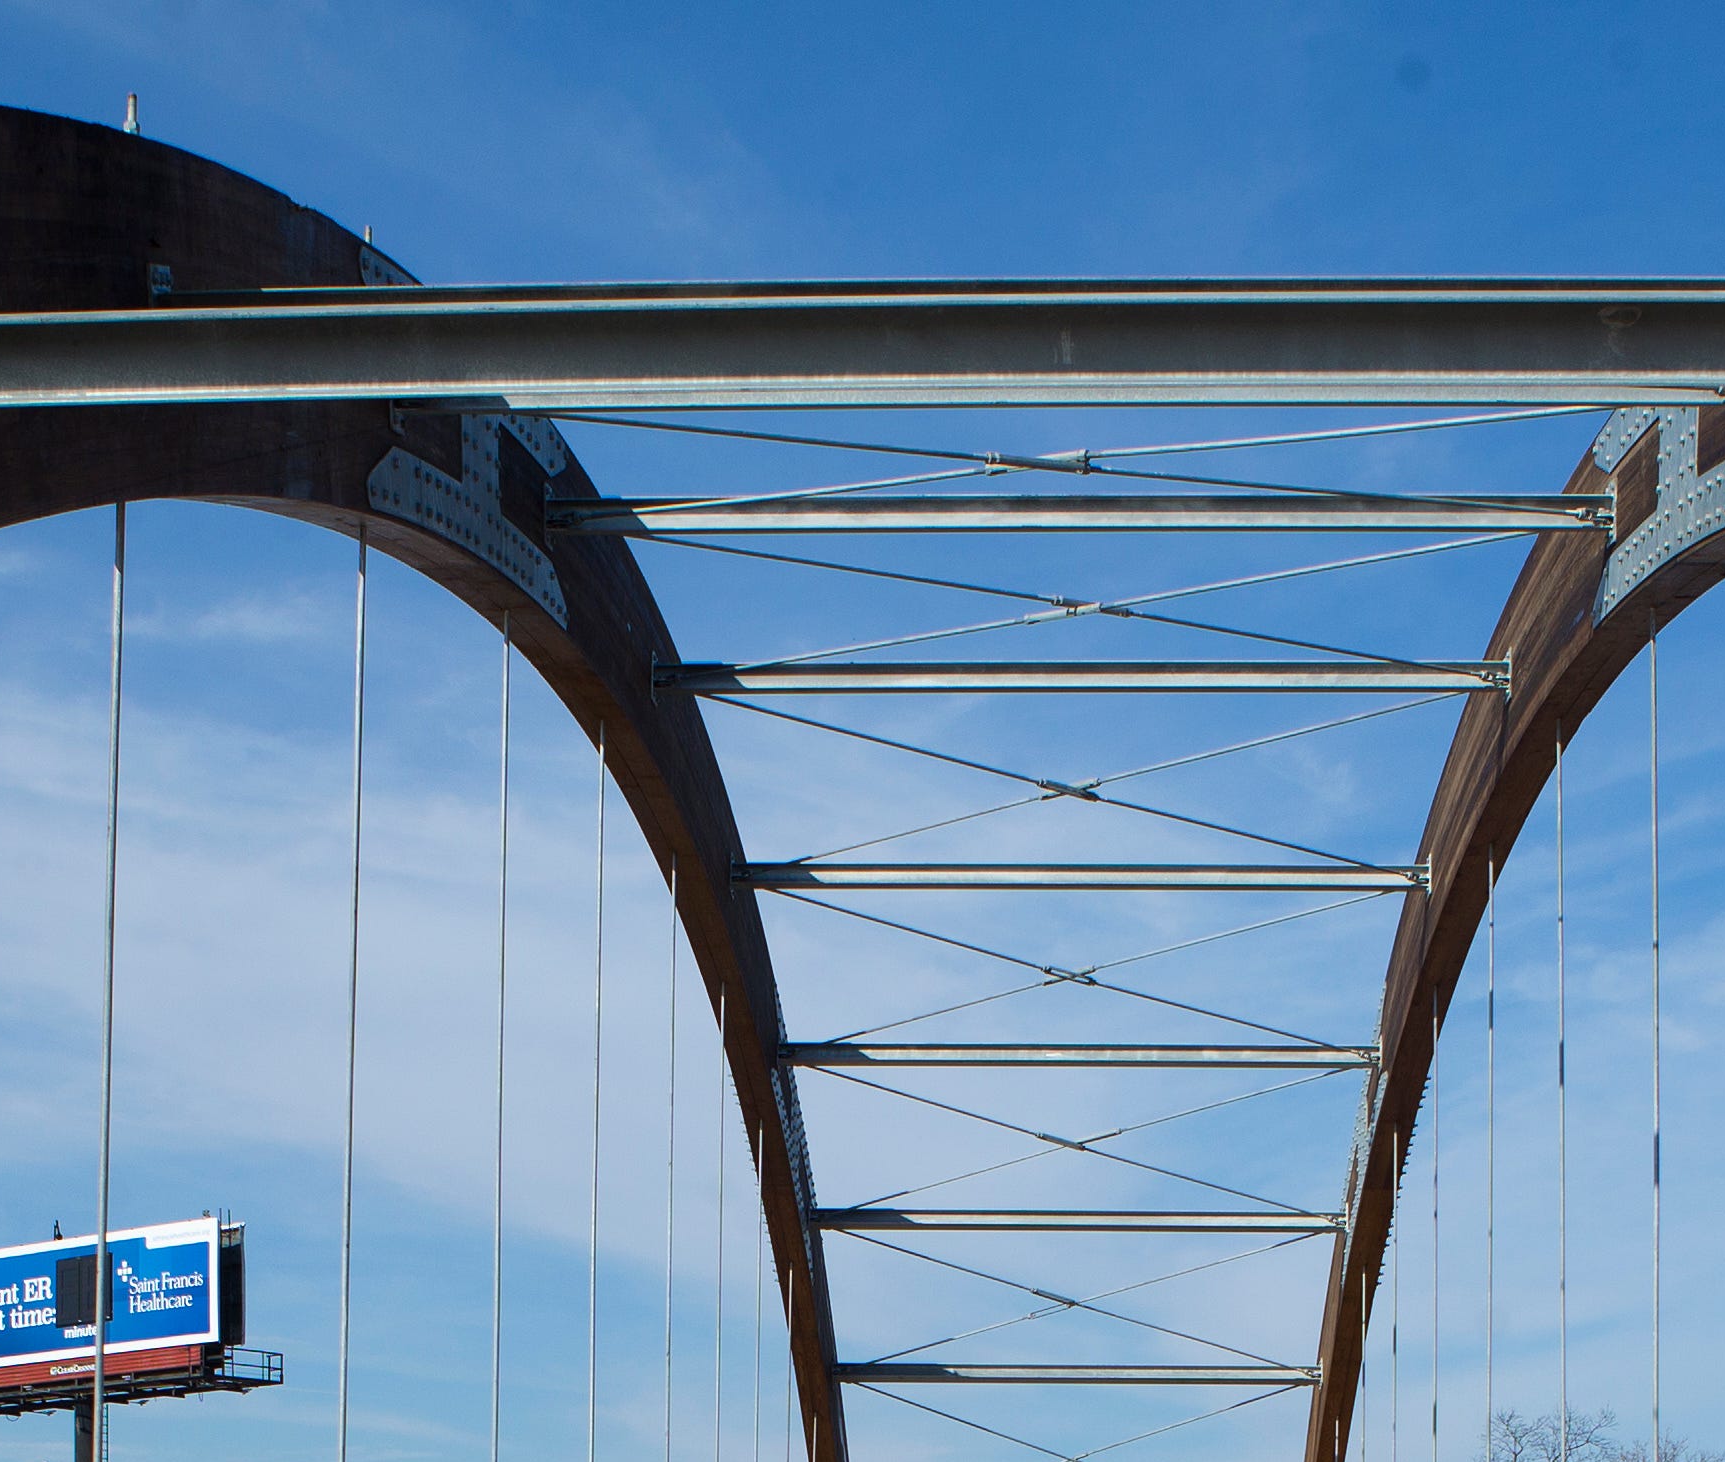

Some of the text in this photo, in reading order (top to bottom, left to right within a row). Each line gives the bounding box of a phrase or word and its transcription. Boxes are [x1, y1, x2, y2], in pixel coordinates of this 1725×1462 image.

[23, 1276, 54, 1303] ER
[129, 1271, 204, 1294] Saint Francis
[129, 1291, 194, 1313] Healthcare
[8, 1305, 57, 1329] time:
[64, 1324, 98, 1339] minute
